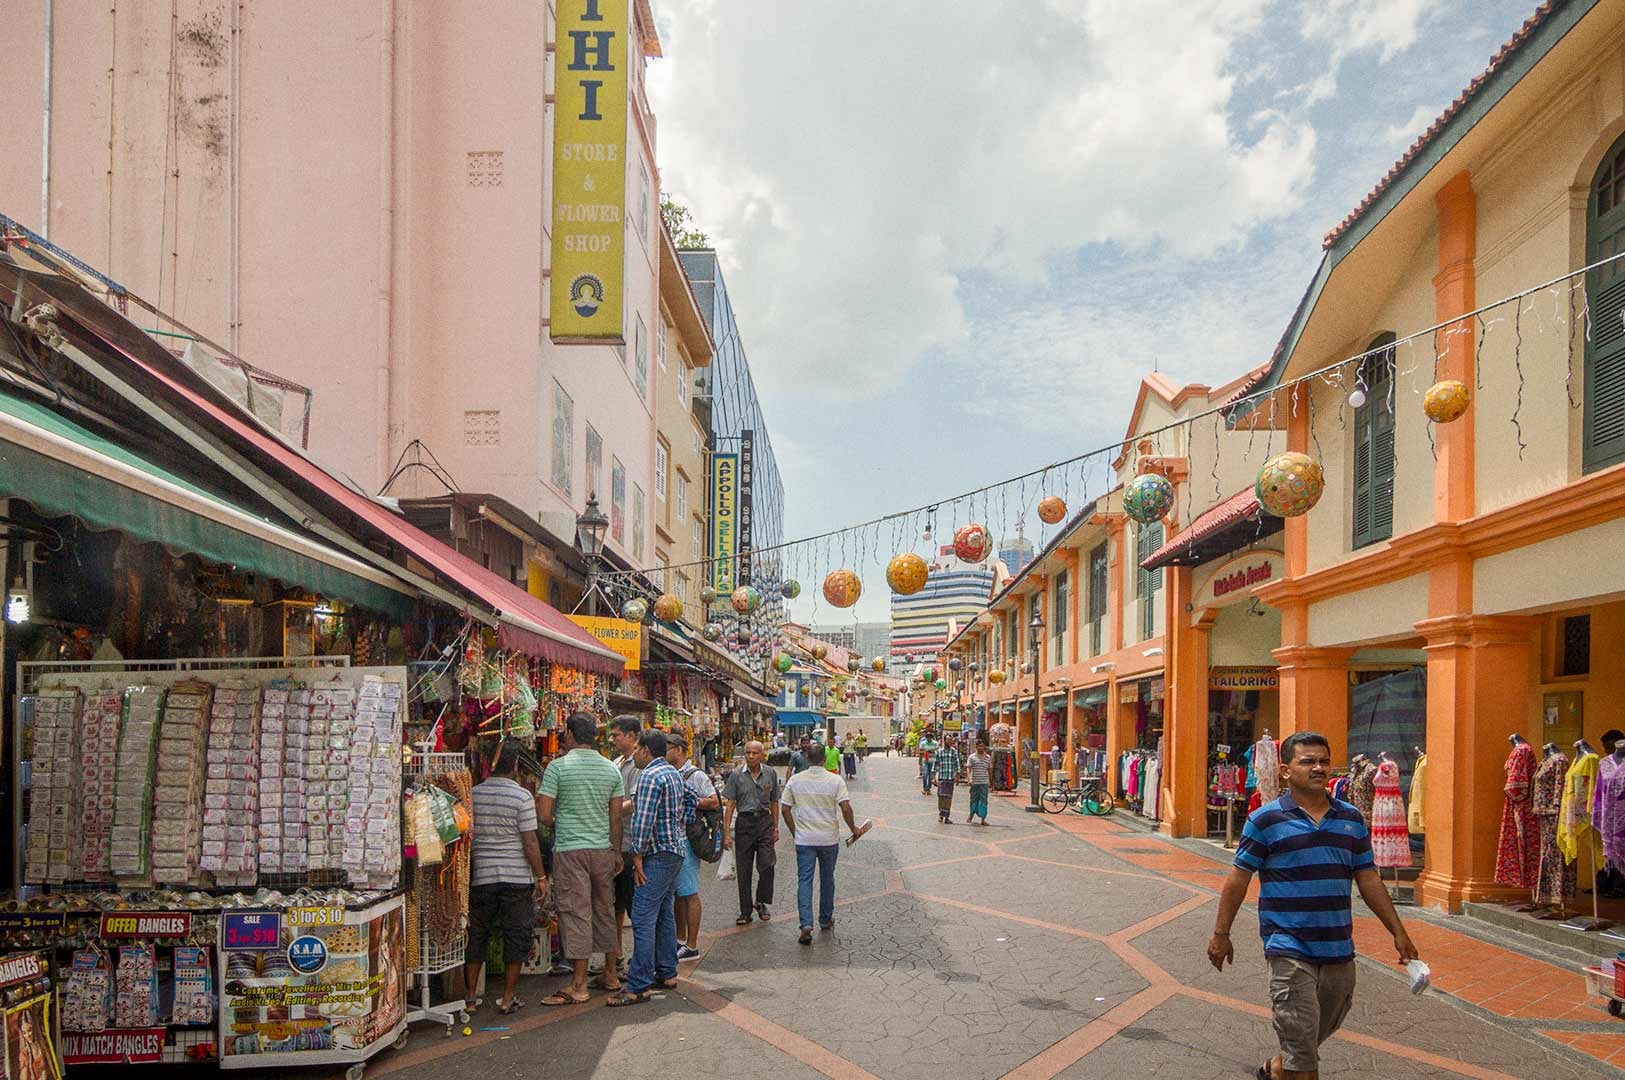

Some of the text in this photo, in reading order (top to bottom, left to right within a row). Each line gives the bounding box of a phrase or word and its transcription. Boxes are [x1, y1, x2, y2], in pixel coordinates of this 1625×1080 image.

[562, 144, 617, 161] STORE
[583, 174, 594, 192] &
[557, 204, 620, 224] FLOWER
[564, 235, 611, 252] SHOP
[718, 461, 731, 591] APPOLLO SELLAPS
[594, 627, 619, 639] FLOWER
[621, 629, 638, 640] SHOP
[1214, 676, 1277, 686] TAILORING
[23, 917, 31, 927] 3
[243, 915, 261, 924] SALE
[291, 910, 297, 923] 3
[300, 909, 316, 923] for
[107, 917, 185, 933] OFFER BANGLES
[229, 928, 237, 943] 3
[241, 985, 279, 995] Costume
[62, 1034, 159, 1057] MIX MATCH BANGLES
